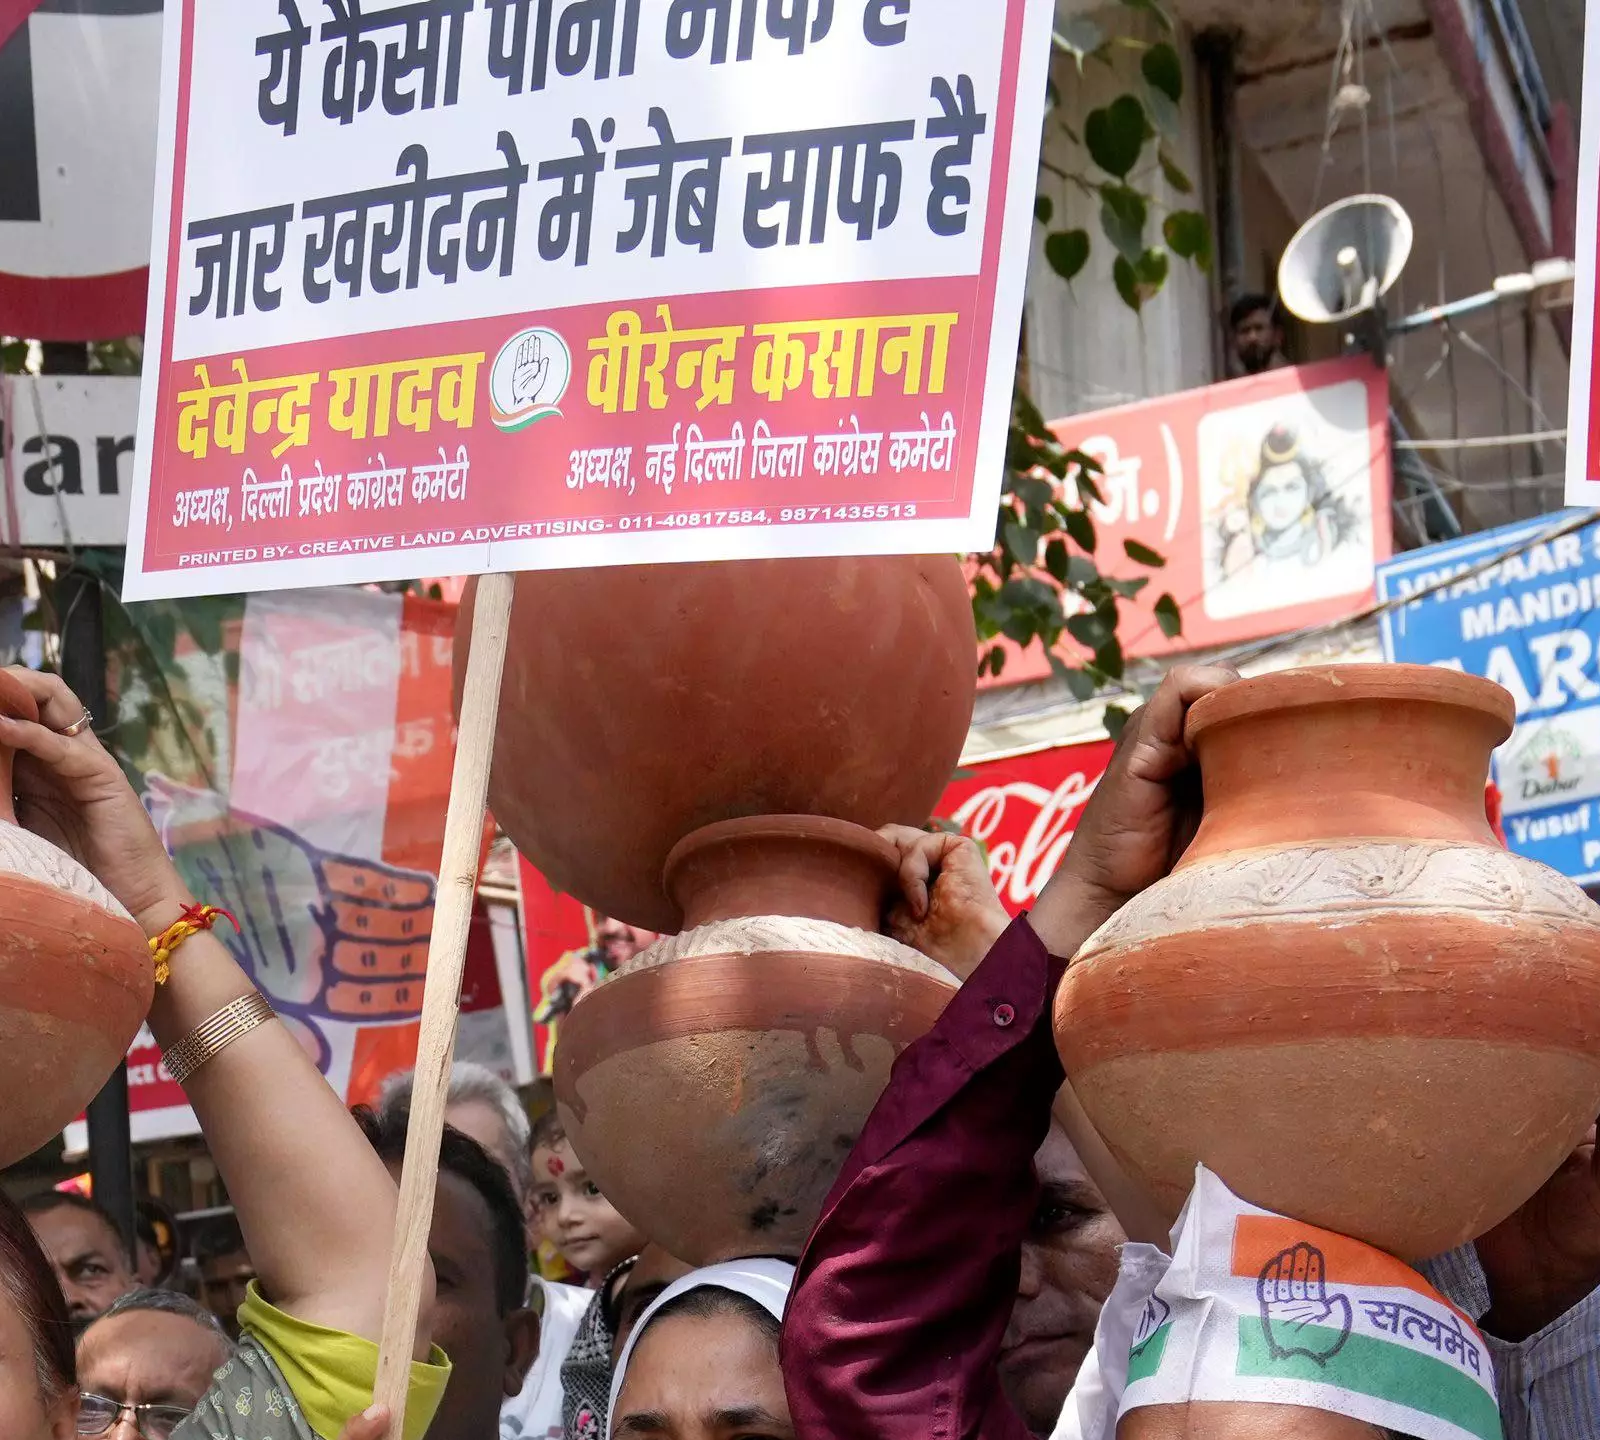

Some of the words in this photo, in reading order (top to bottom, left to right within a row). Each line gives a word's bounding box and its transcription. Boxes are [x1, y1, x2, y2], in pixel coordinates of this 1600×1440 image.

[187, 203, 295, 320] जार
[301, 130, 530, 305] खरीदने
[537, 117, 616, 268] में
[613, 106, 733, 259] जेब
[741, 119, 916, 250] साफ
[925, 73, 987, 237] है
[586, 303, 746, 414] वीरेन्द्र
[750, 312, 960, 402] कसाना
[176, 358, 320, 460] देवेन्द्र
[327, 351, 486, 441] यादव
[171, 486, 233, 532] अध्यक्ष,
[240, 462, 294, 523] दिल्ली
[297, 459, 342, 519] प्रदेश
[346, 451, 407, 512] कांग्रेस
[411, 444, 470, 504] कमेटी
[565, 444, 636, 497] अध्यक्ष,
[644, 421, 683, 495] नई
[683, 419, 746, 484] दिल्ली
[750, 418, 808, 480] जिला
[812, 413, 884, 478] कांग्रेस
[887, 409, 957, 473] कमेटी
[178, 543, 258, 567] PRINTED
[262, 541, 294, 561] BY-
[299, 535, 395, 557] CREATIVE
[400, 529, 456, 547] LAND
[459, 515, 613, 542] ADVERTISING-
[618, 509, 772, 531] 011-40817584,
[779, 504, 918, 522] 9871435513
[1510, 810, 1590, 844] Yusuf
[1519, 774, 1585, 801] Dabur
[1357, 1299, 1481, 1377] सत्यमेव
